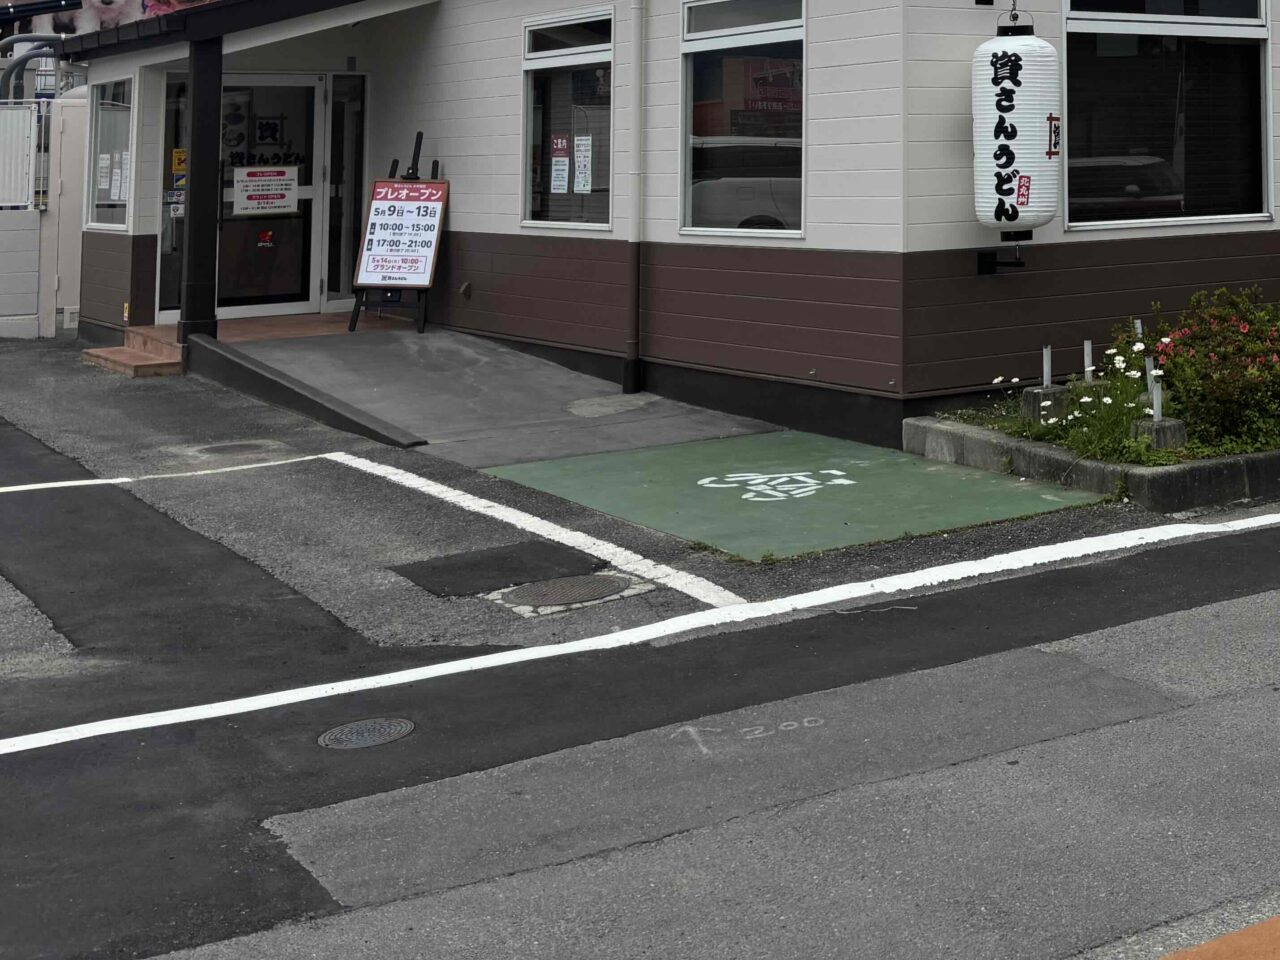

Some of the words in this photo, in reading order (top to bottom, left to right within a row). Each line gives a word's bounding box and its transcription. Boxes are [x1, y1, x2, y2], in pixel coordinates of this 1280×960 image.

[990, 50, 1023, 222] 資さんうどん
[376, 187, 442, 200] プレオープン
[1018, 177, 1030, 205] 北九州
